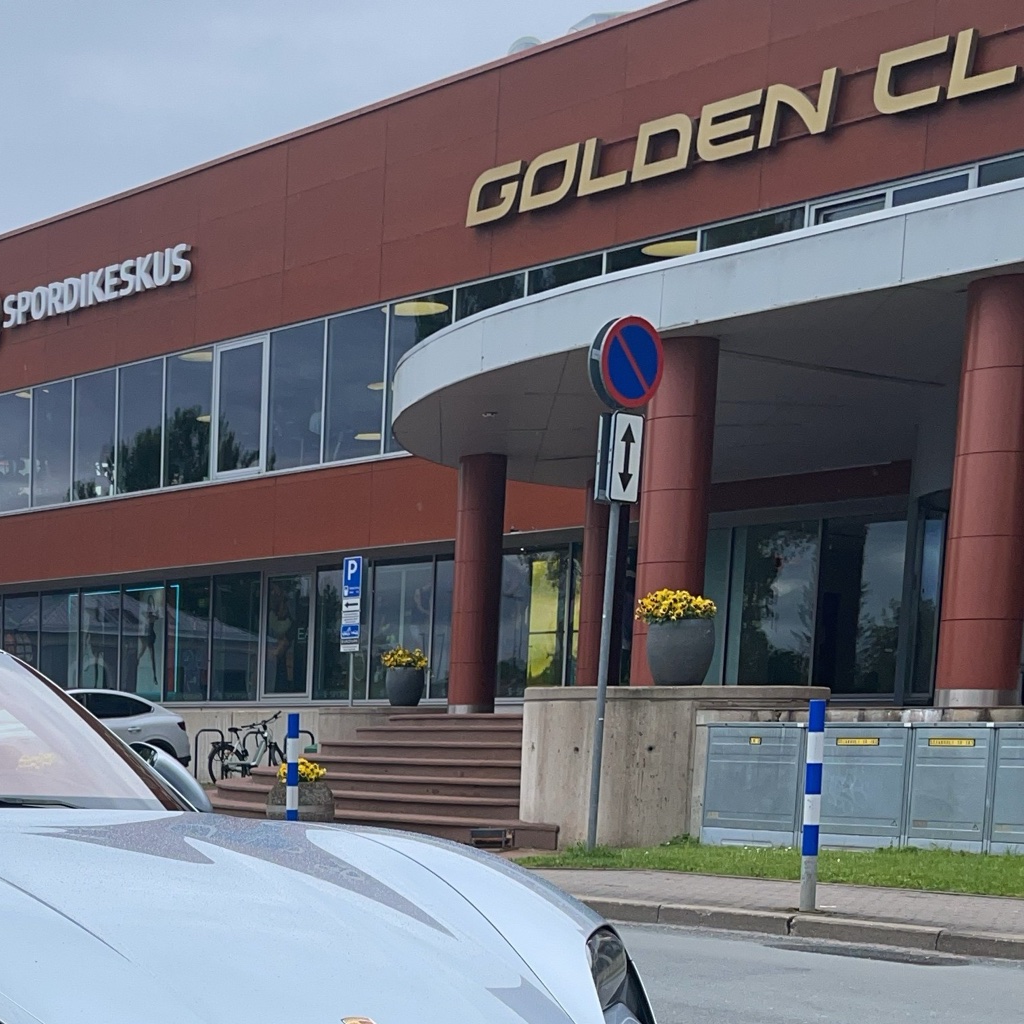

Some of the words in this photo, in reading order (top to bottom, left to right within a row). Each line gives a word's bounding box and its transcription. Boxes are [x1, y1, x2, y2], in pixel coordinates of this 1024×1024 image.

[465, 66, 839, 228] GOLDEN
[873, 27, 1019, 115] CL
[3, 243, 192, 329] SPORDIKESKUS
[347, 559, 358, 581] P
